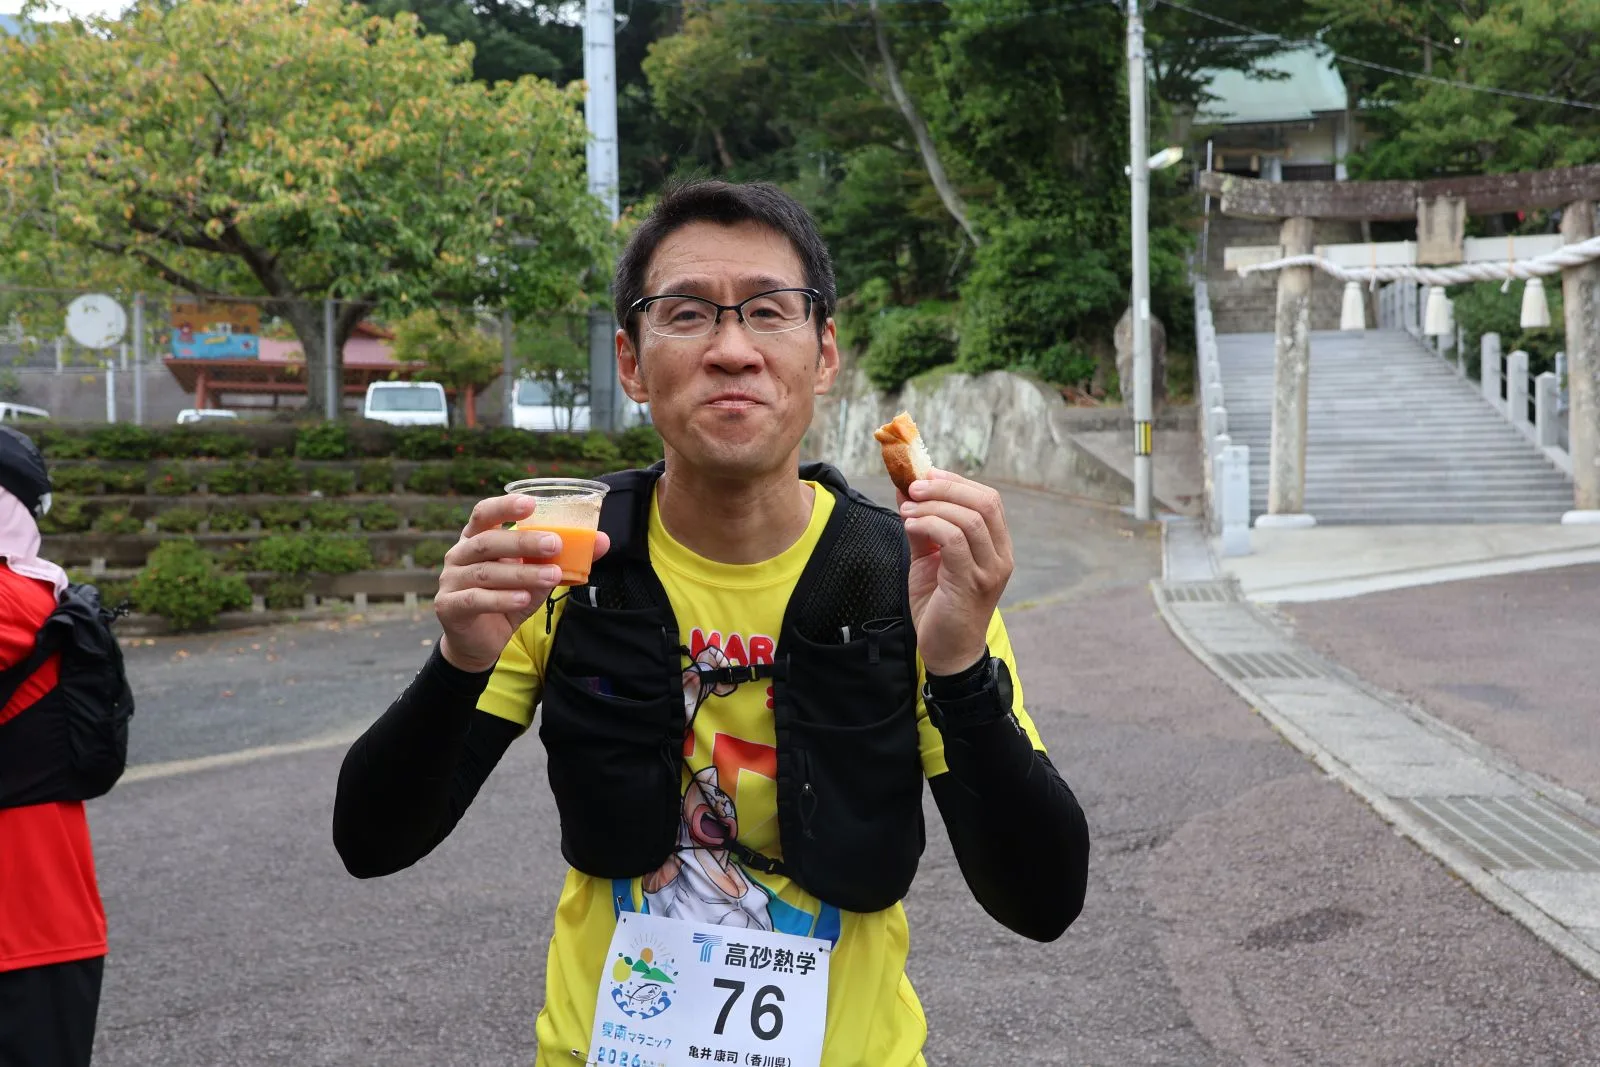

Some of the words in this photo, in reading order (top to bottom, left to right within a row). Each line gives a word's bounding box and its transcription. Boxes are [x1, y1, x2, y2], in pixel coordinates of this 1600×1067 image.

[724, 942, 816, 975] 高砂熱学
[713, 977, 785, 1041] 76
[597, 1046, 640, 1067] 2026
